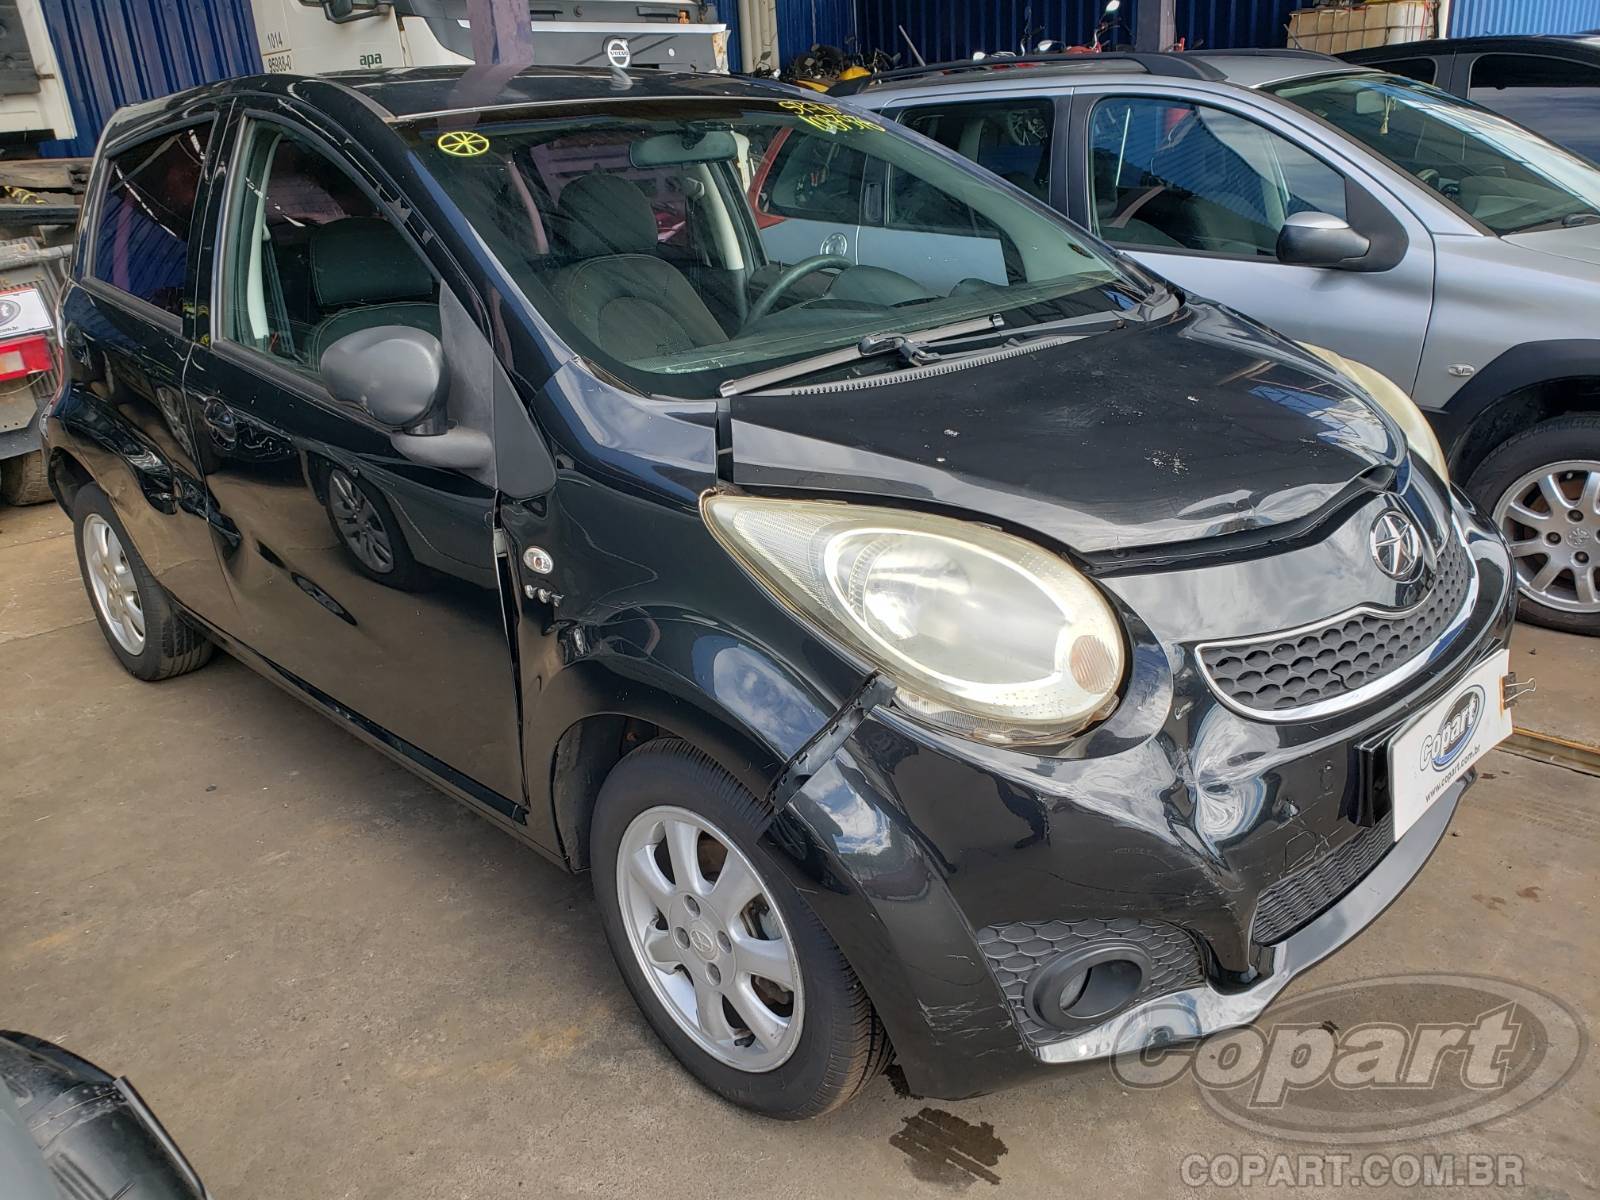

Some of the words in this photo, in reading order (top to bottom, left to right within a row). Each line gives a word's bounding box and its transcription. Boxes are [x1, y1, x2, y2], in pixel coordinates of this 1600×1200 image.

[267, 32, 283, 48] 1014
[360, 53, 383, 68] apa
[1420, 692, 1480, 771] Copart
[1425, 744, 1480, 803] www.copart.com.br
